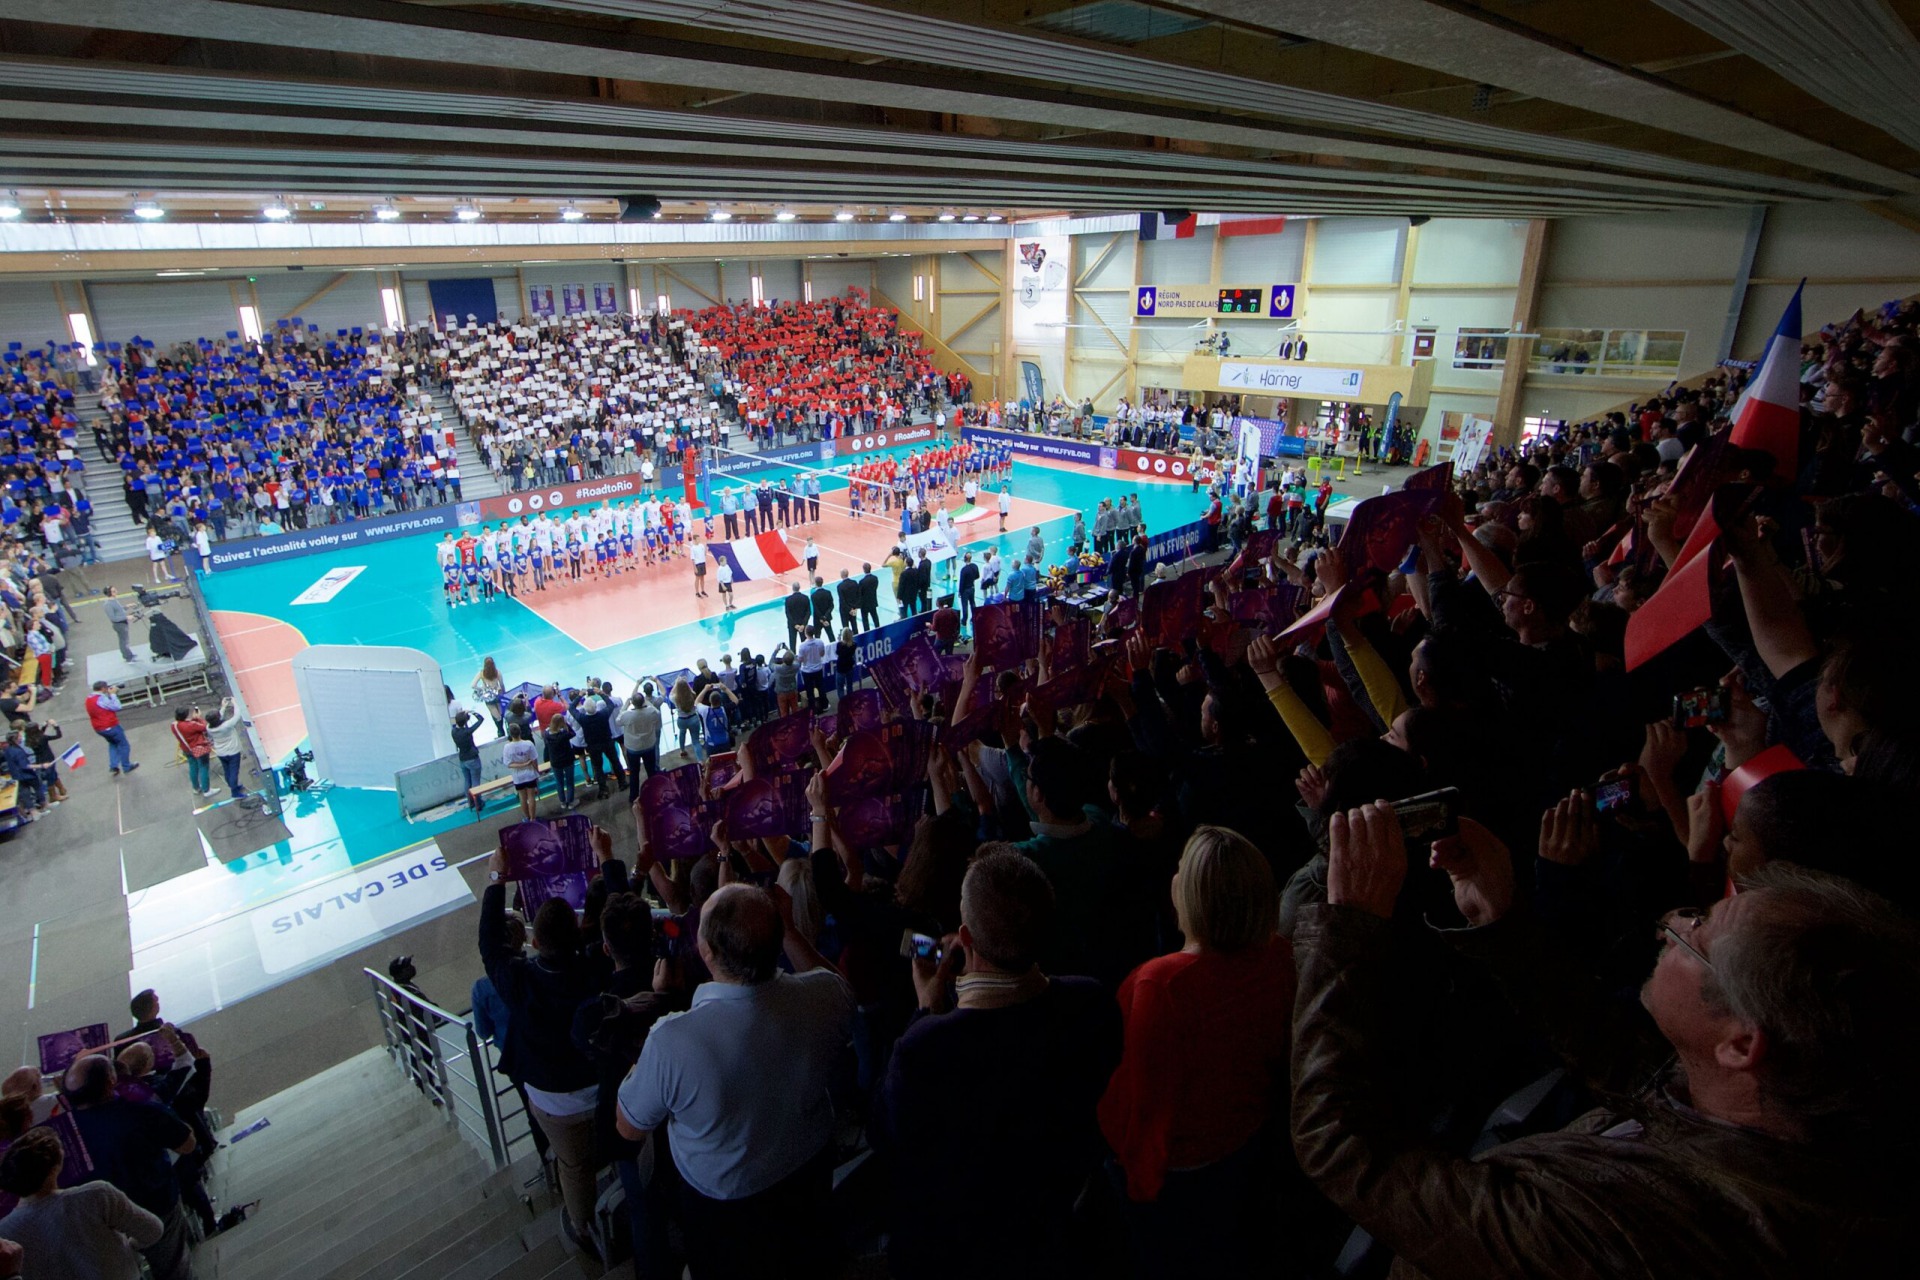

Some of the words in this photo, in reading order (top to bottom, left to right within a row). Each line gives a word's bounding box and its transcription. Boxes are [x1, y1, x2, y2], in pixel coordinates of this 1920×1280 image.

[1158, 290, 1180, 299] RÉGION
[1196, 300, 1219, 308] CALAIS
[1260, 370, 1302, 389] Harnes
[894, 429, 931, 442] #RoadtoRio
[1043, 445, 1091, 459] WWW.FFVB.ORG
[732, 461, 750, 470] volley
[575, 479, 633, 499] #RoadtoRio
[212, 549, 252, 565] Suivez
[253, 540, 307, 558] l'actualité
[309, 535, 340, 549] volley
[342, 531, 358, 543] sur
[365, 515, 444, 538] WWW.FFVB.ORG
[1146, 530, 1200, 563] WWW.FFVBORG
